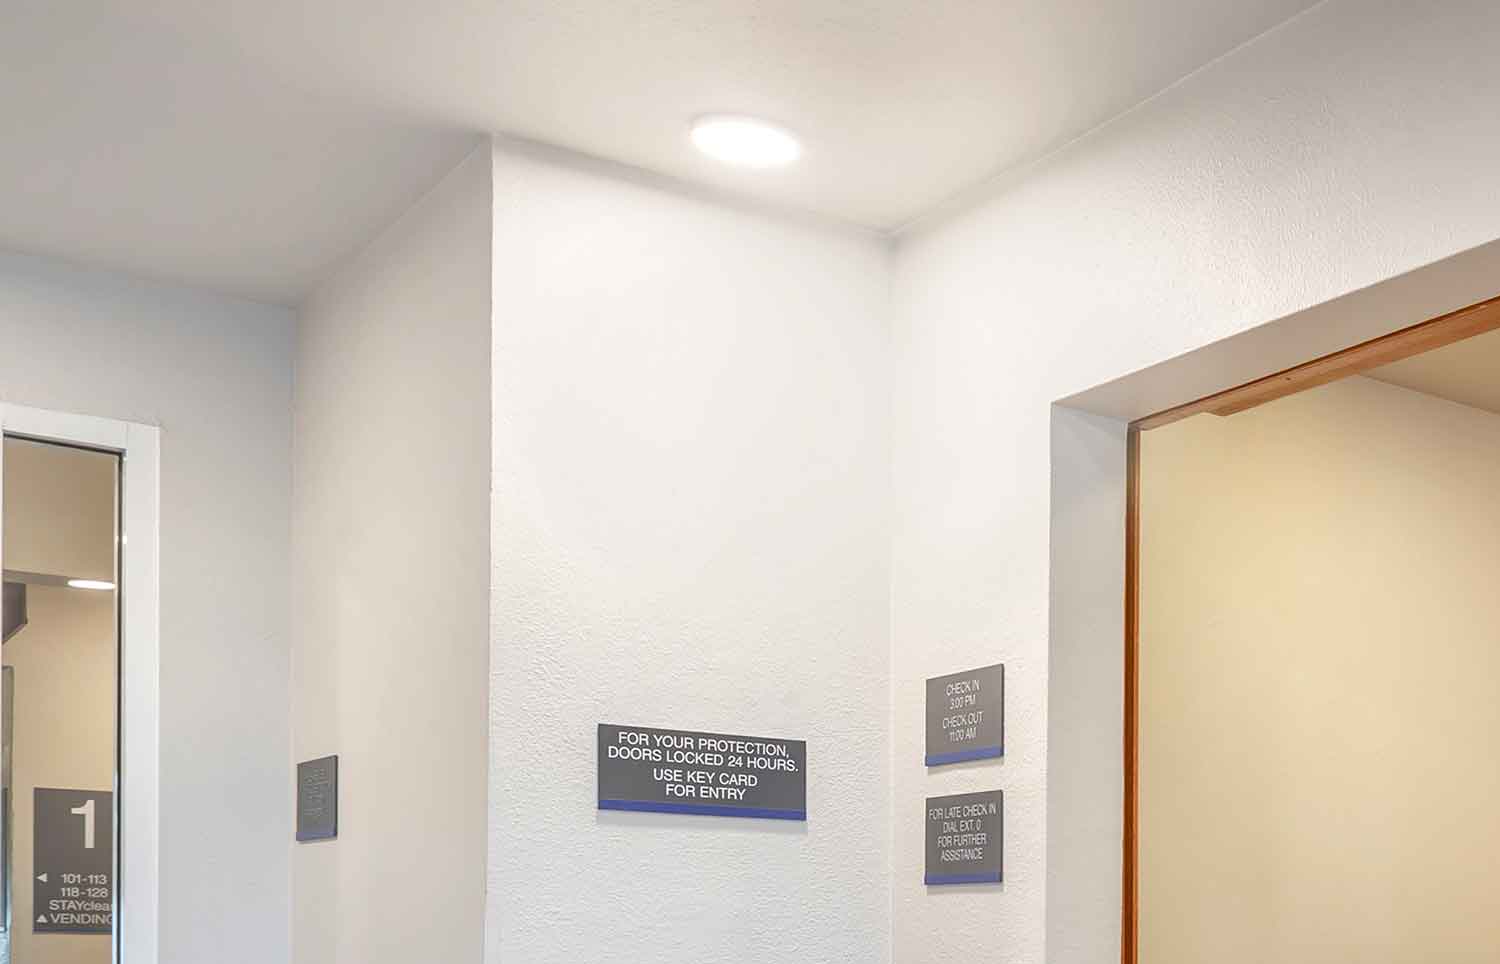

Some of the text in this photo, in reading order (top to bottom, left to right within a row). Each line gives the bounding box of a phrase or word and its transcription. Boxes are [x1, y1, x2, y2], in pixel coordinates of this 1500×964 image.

[946, 680, 980, 696] CHECK IN
[965, 695, 976, 706] PM
[943, 711, 983, 729] CHECK OUT
[966, 727, 976, 740] AM
[618, 732, 789, 757] FOR YOUR PROTECTION,
[608, 746, 799, 772] DOORS LOCKED 24 HOURS.
[654, 769, 758, 787] USE KEY CARD
[666, 784, 746, 800] FOR ENTRY
[929, 803, 996, 820] FOR LATE CHECK IN
[71, 799, 95, 848] 1
[943, 821, 958, 833] DIAL
[976, 819, 981, 830] 0
[938, 833, 987, 847] FOR FURTHER
[941, 847, 983, 861] ASSISTANCE
[61, 873, 107, 885] 101-113
[61, 887, 108, 898] 118-128
